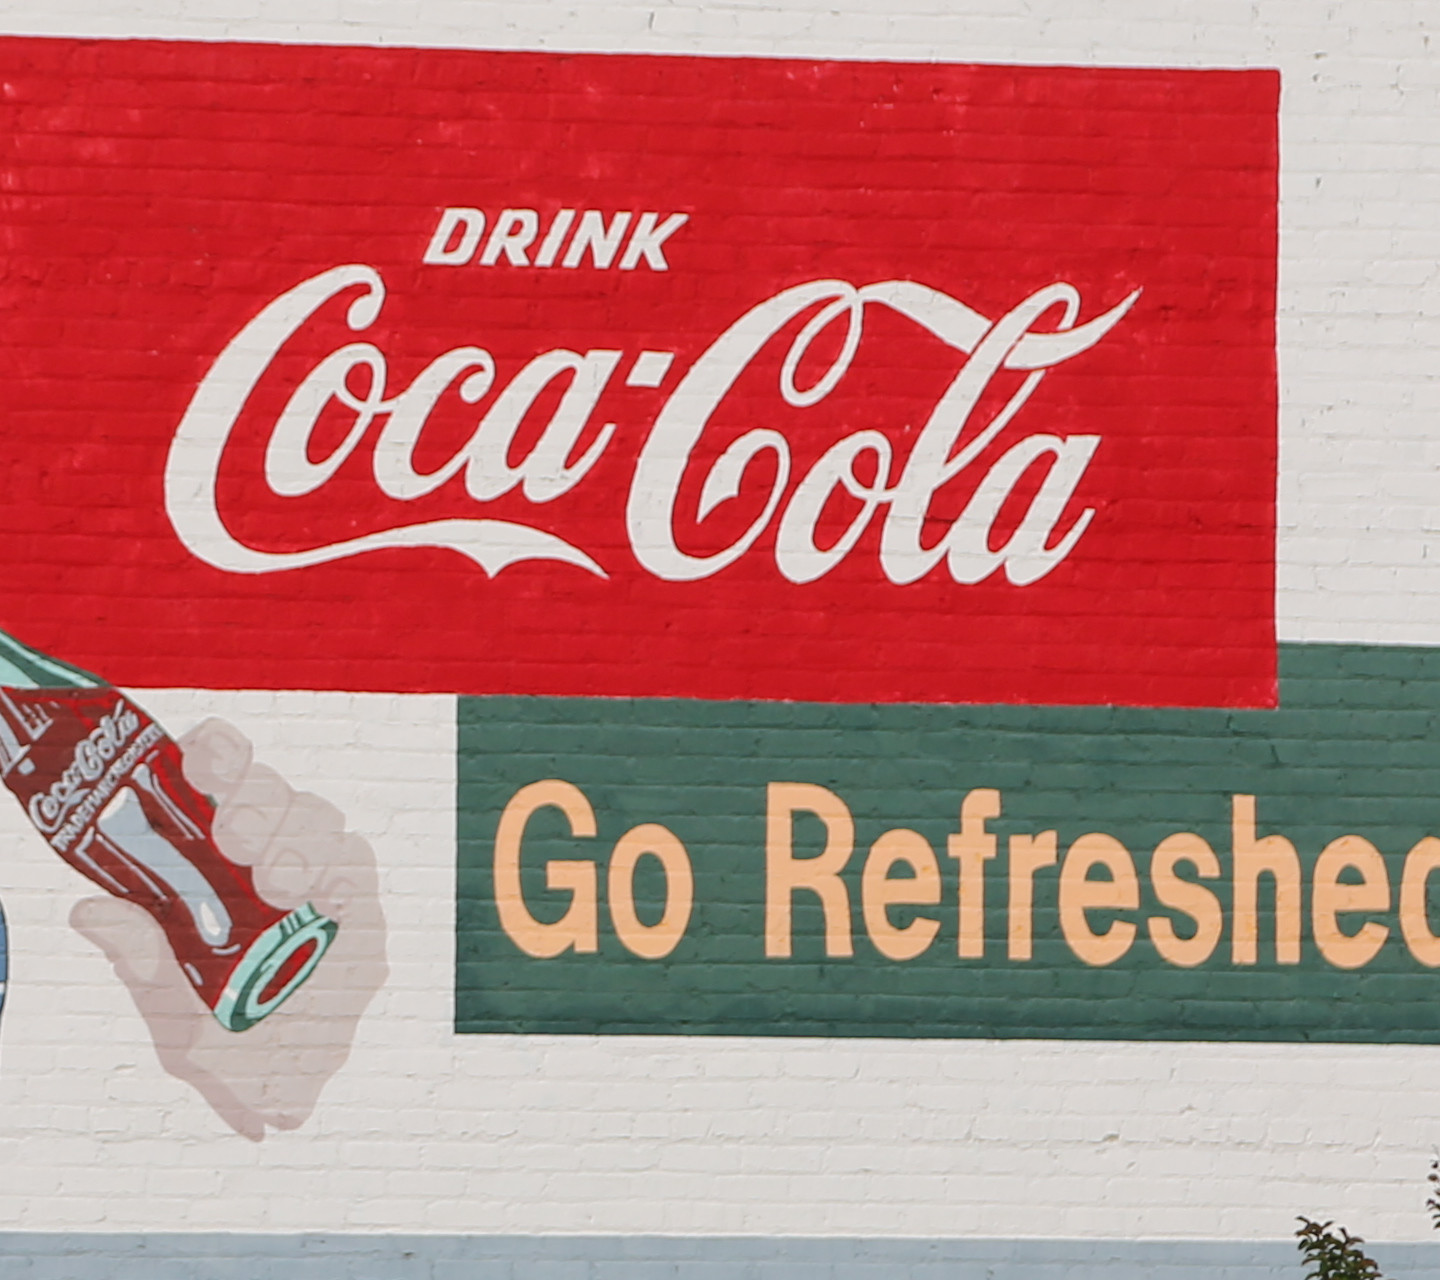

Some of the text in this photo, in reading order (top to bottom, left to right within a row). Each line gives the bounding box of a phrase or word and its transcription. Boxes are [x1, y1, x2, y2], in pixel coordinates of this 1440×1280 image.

[422, 207, 689, 271] DRINK
[164, 264, 1142, 587] Coca-Cola
[492, 779, 694, 959] Go
